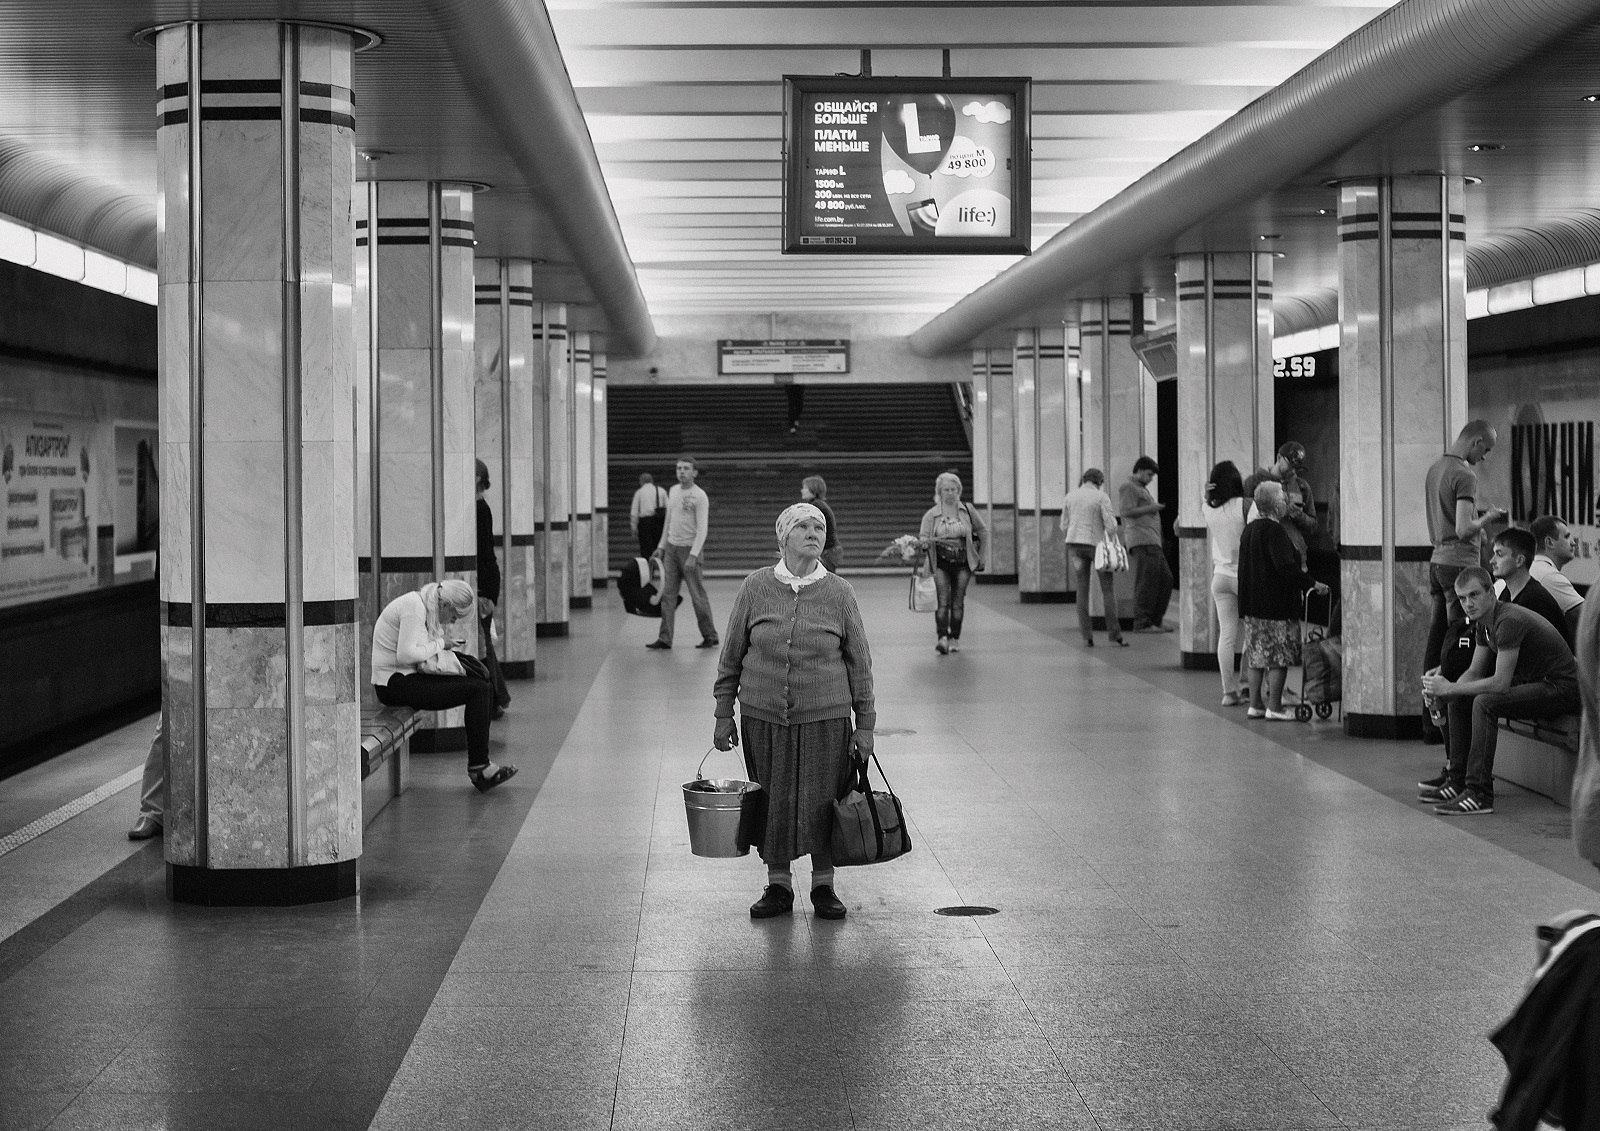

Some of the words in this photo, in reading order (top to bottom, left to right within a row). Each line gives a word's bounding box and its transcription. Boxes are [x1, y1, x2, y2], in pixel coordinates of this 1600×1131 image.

[814, 99, 878, 114] ОБЩАЙСЯ
[814, 113, 868, 125] БОЛЬШЕ
[903, 102, 941, 154] L
[814, 129, 857, 140] ПЛАТИ
[814, 141, 870, 152] МЕНЬШЕ
[948, 160, 962, 170] 49
[964, 158, 987, 169] 800
[814, 179, 836, 189] 1500
[814, 189, 832, 199] 300
[814, 200, 827, 210] 49
[827, 200, 845, 210] 800
[958, 206, 996, 227] life:)
[1511, 421, 1594, 525] КУХНИ
